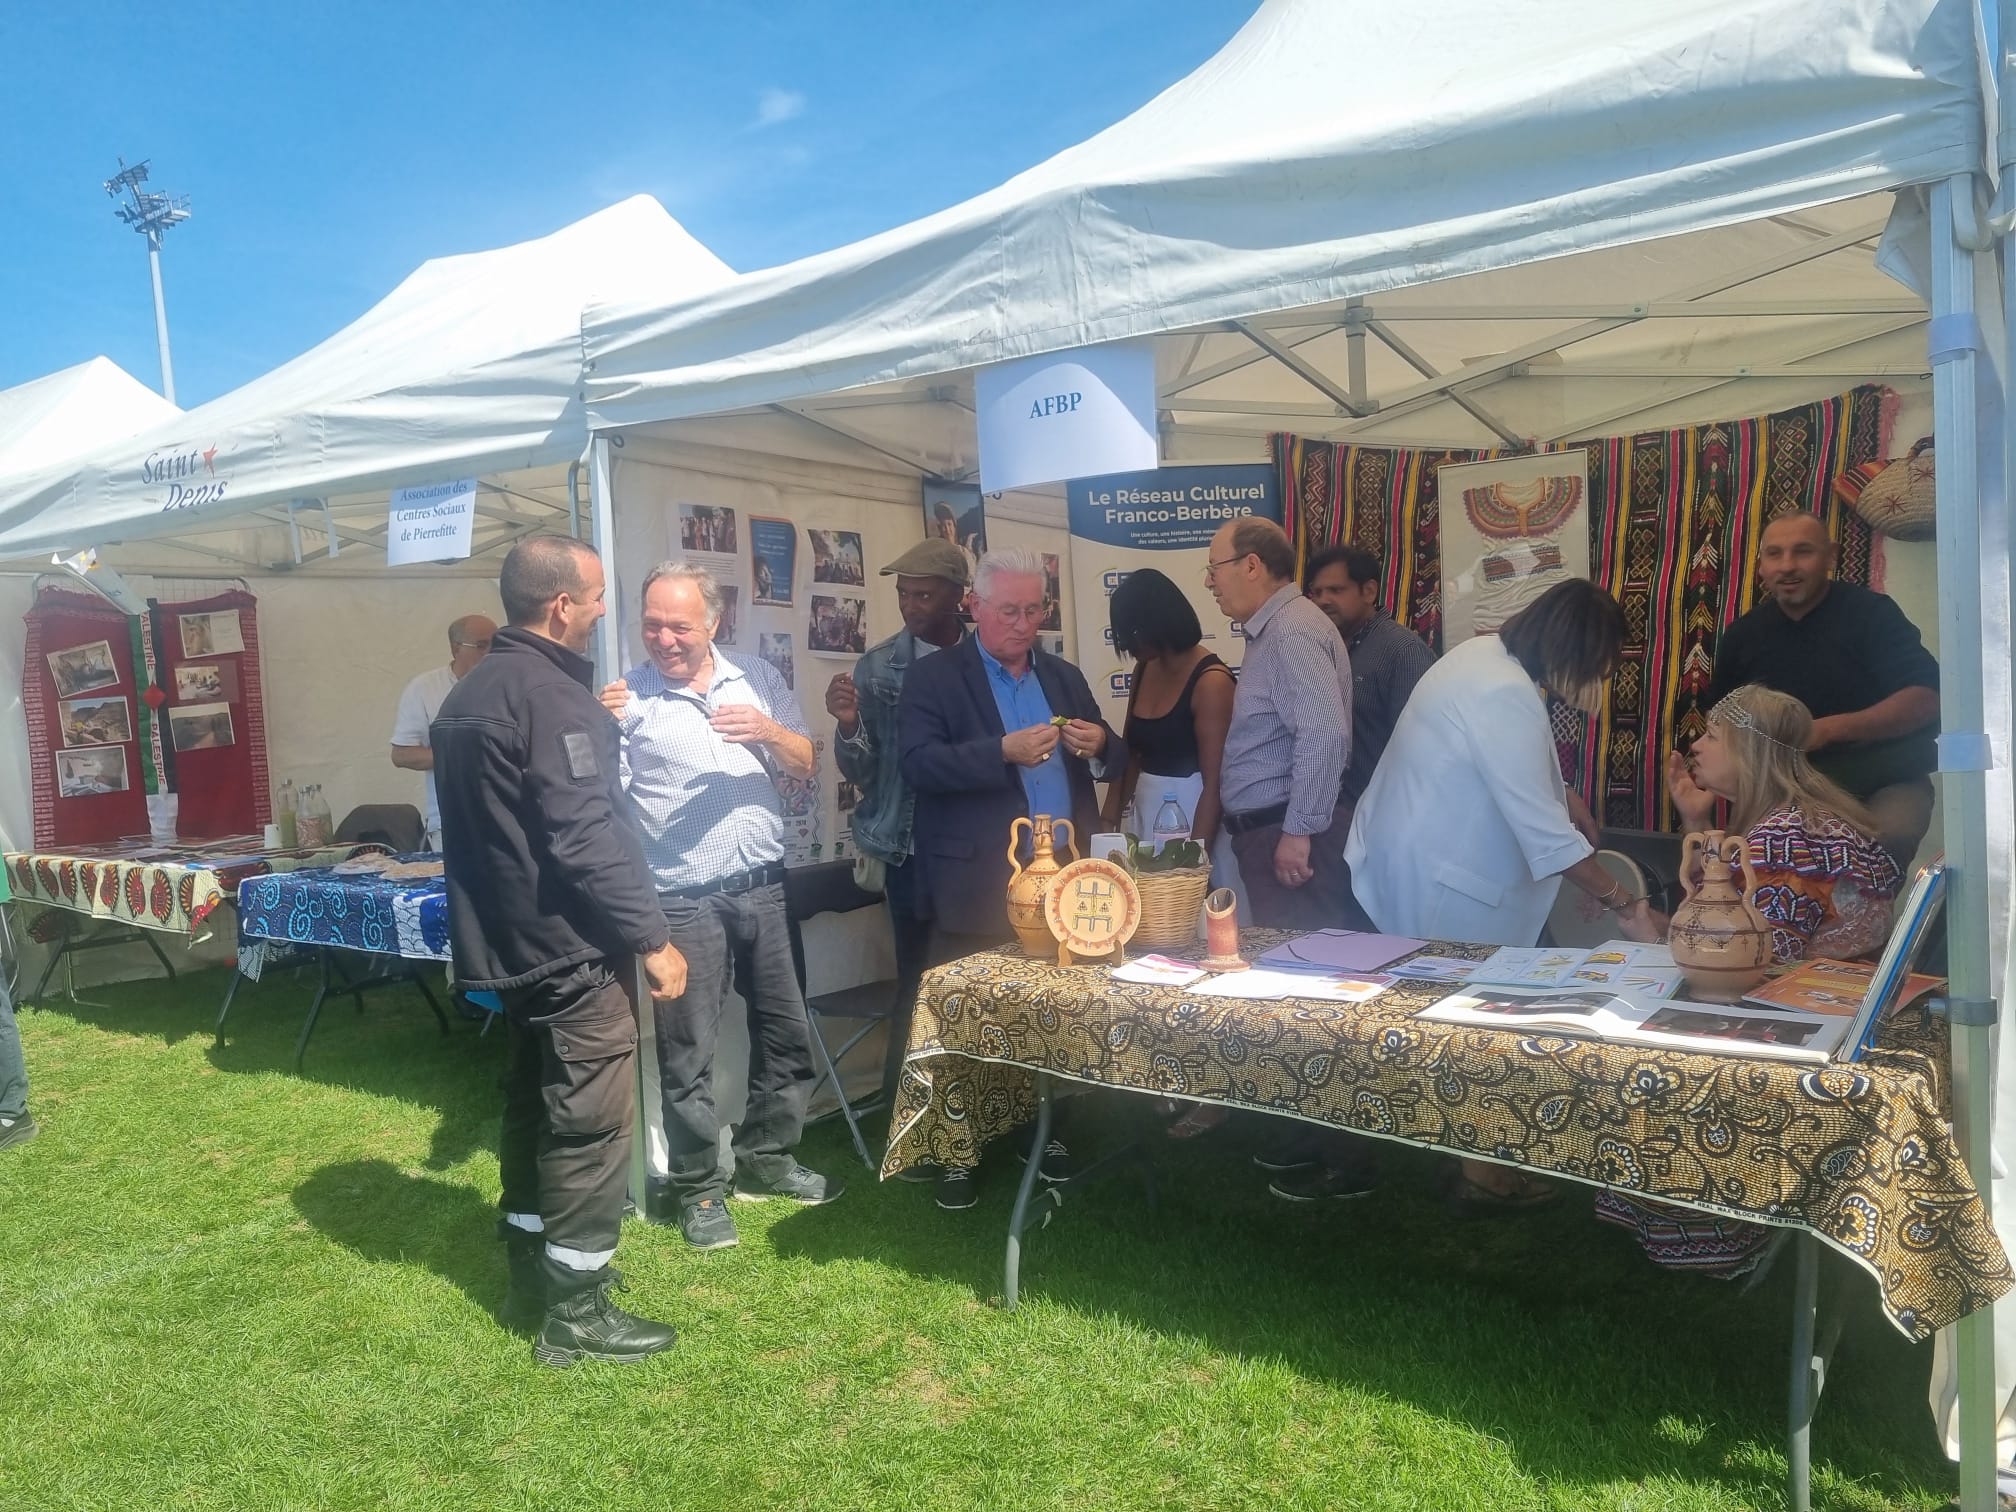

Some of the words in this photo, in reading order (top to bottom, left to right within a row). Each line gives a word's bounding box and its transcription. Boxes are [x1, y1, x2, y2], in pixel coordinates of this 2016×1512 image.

[1028, 391, 1083, 419] AFBP
[141, 448, 198, 485] Saint
[161, 480, 228, 512] Denis
[400, 484, 451, 502] Association
[452, 479, 468, 494] des
[1088, 491, 1110, 506] Le
[1116, 488, 1185, 505] Réseau
[1190, 484, 1265, 502] Culturel
[396, 508, 432, 522] Centres
[432, 502, 467, 518] Sociaux
[1105, 503, 1253, 524] Franco-Berbère
[400, 528, 412, 542] de
[413, 523, 457, 541] Pierrefitte
[151, 723, 166, 785] PALESTINE
[1734, 1208, 1756, 1219] BLOCK
